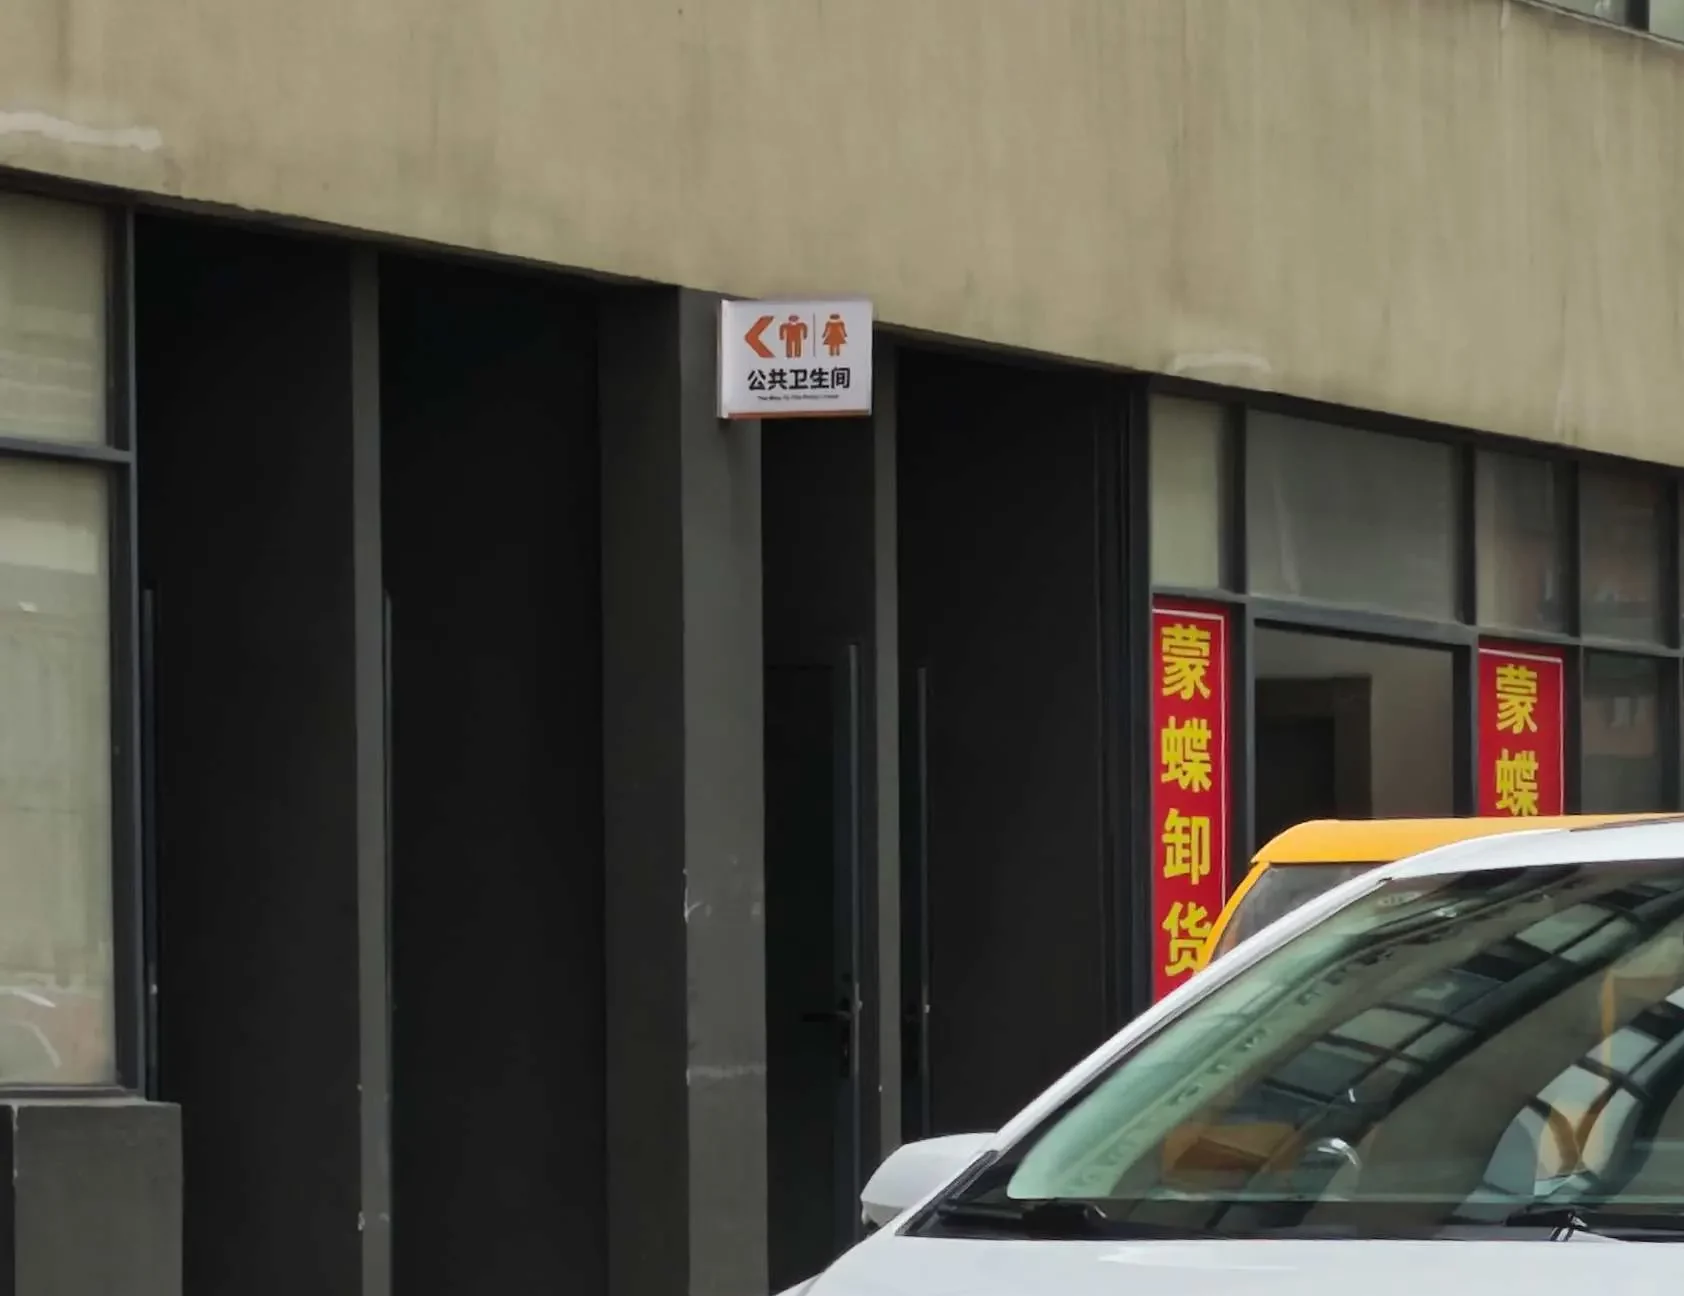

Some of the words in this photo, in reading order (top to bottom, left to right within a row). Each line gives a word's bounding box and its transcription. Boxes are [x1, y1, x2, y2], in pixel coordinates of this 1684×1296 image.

[747, 366, 850, 391] 公共卫生间
[1161, 623, 1212, 977] 蒙蝶卸货
[1495, 663, 1540, 816] 蒙蝶
